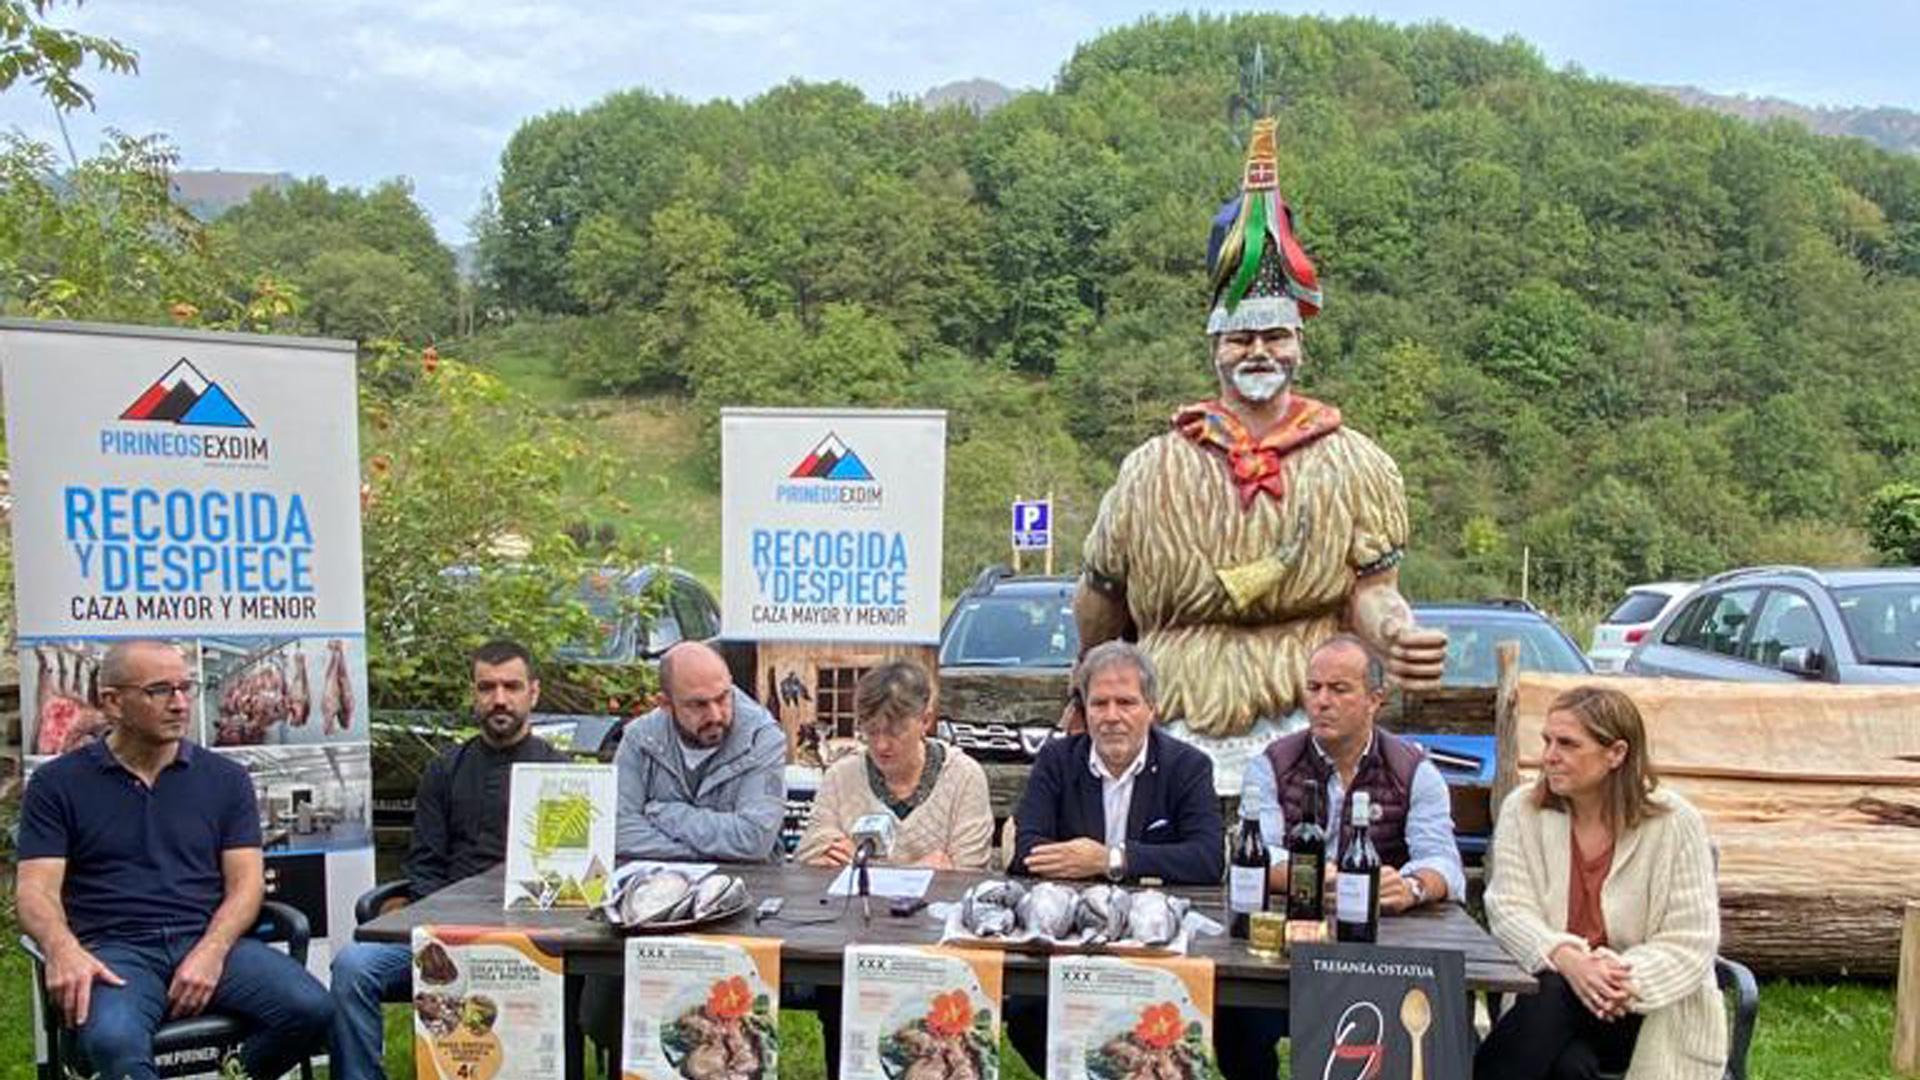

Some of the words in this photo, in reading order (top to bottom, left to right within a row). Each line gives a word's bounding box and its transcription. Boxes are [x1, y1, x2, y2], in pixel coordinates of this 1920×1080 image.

[100, 429, 269, 460] PIRINEOSEXDIM
[65, 486, 313, 545] RECOGIDA
[1024, 506, 1040, 531] P
[752, 529, 908, 569] RECOGIDA
[75, 543, 95, 579] Y
[103, 544, 314, 594] DESPIECE
[758, 568, 770, 593] Y
[773, 570, 907, 605] DESPIECE
[71, 596, 129, 621] CAZA
[137, 596, 213, 621] MAYOR
[220, 597, 234, 621] Y
[240, 597, 317, 621] MENOR
[752, 605, 788, 624] CAZA
[791, 606, 840, 625] MAYOR
[843, 608, 854, 625] Y
[857, 608, 907, 626] MENOR
[858, 959, 887, 970] XXX
[1061, 972, 1091, 982] XXX
[1377, 963, 1435, 978] OSTATUA
